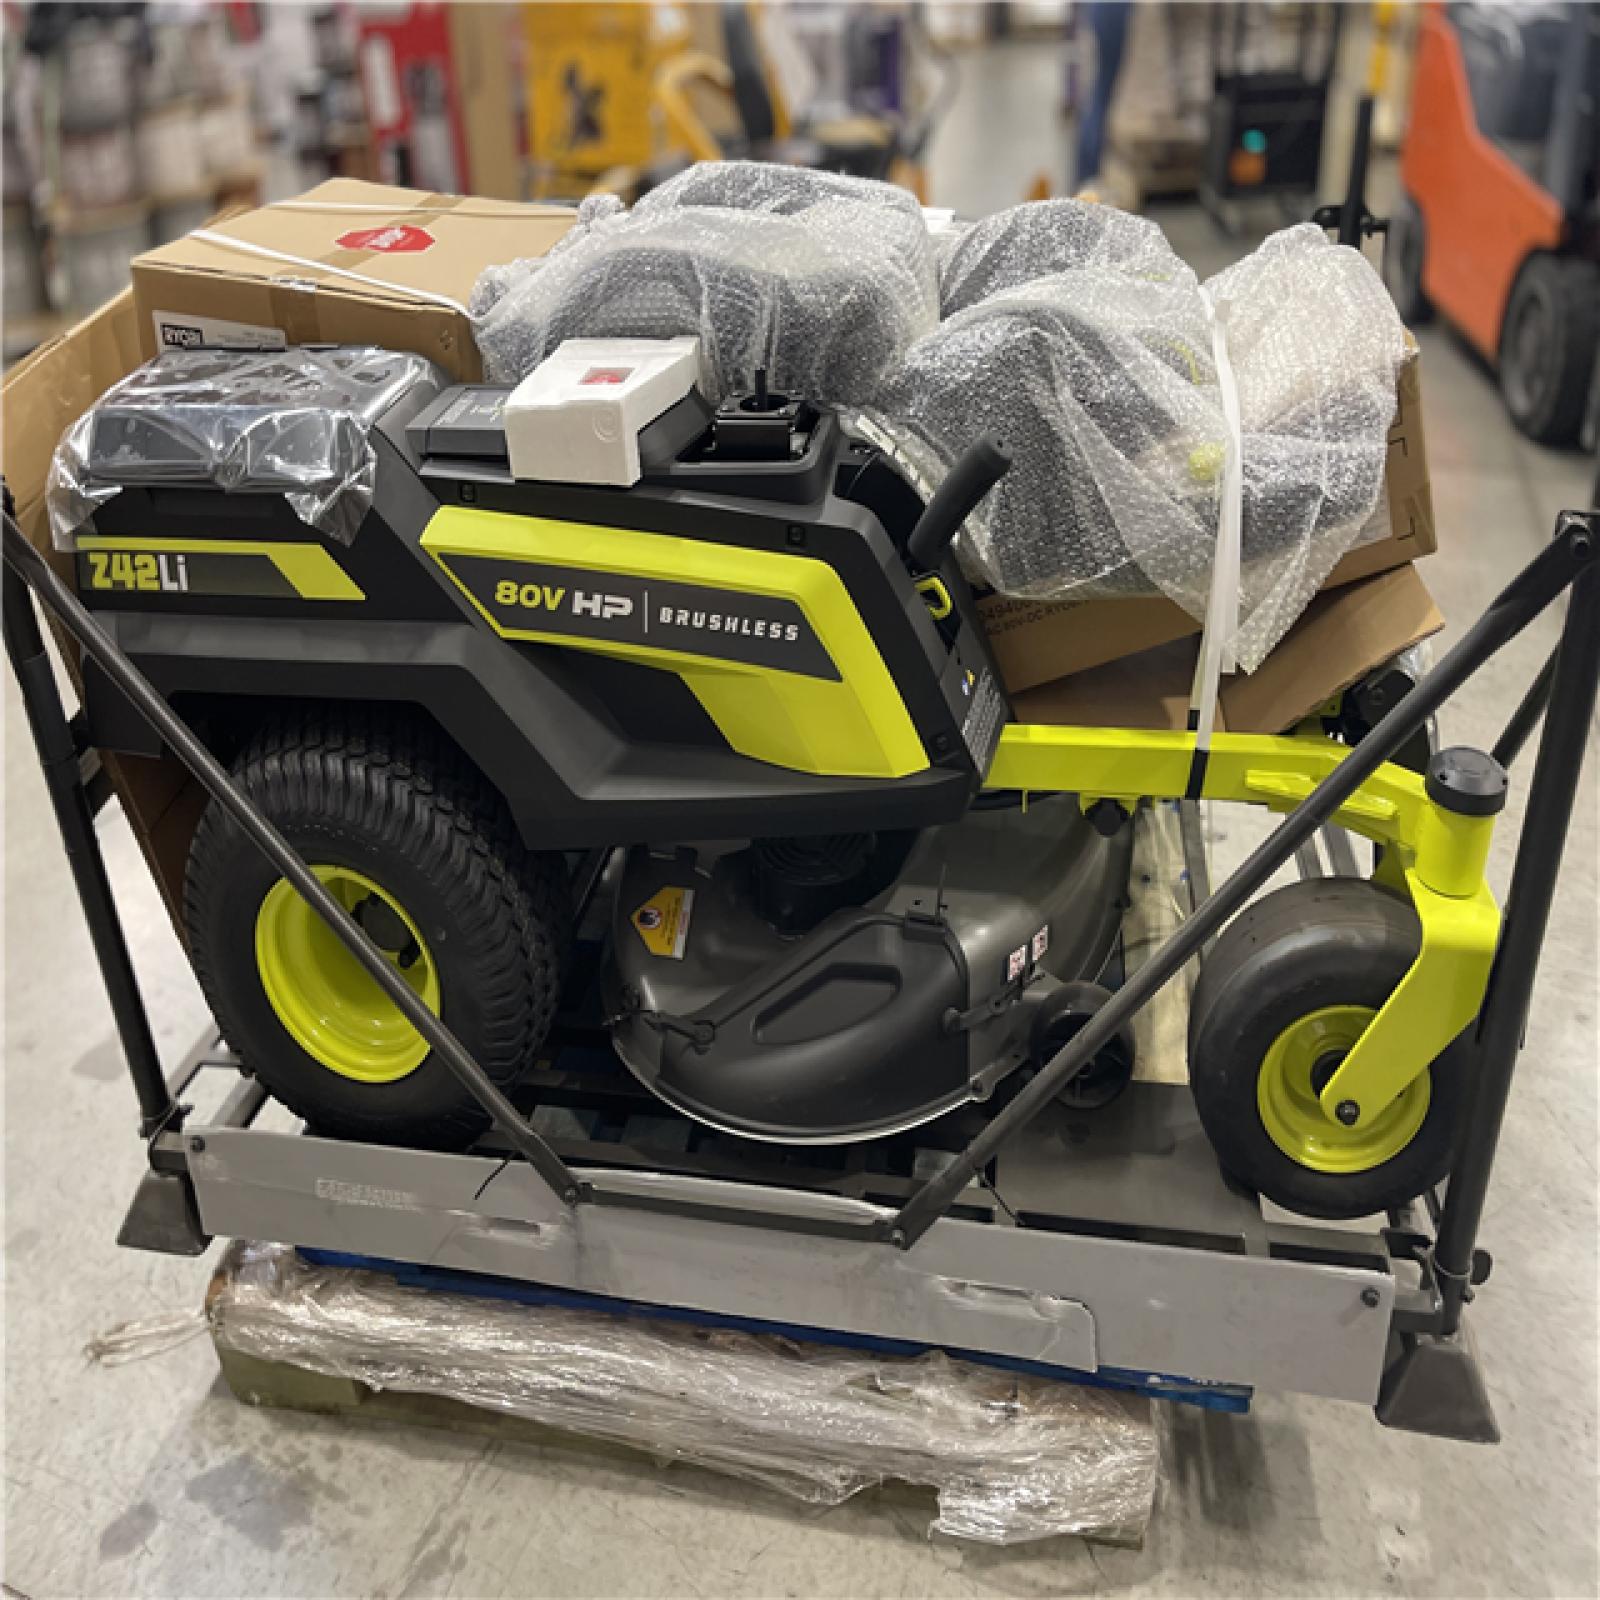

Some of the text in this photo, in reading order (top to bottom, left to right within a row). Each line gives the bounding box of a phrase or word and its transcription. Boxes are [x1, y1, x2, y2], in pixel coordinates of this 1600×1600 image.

[89, 551, 188, 591] Z42Li
[495, 580, 799, 641] 80V HP BRUSHLESS
